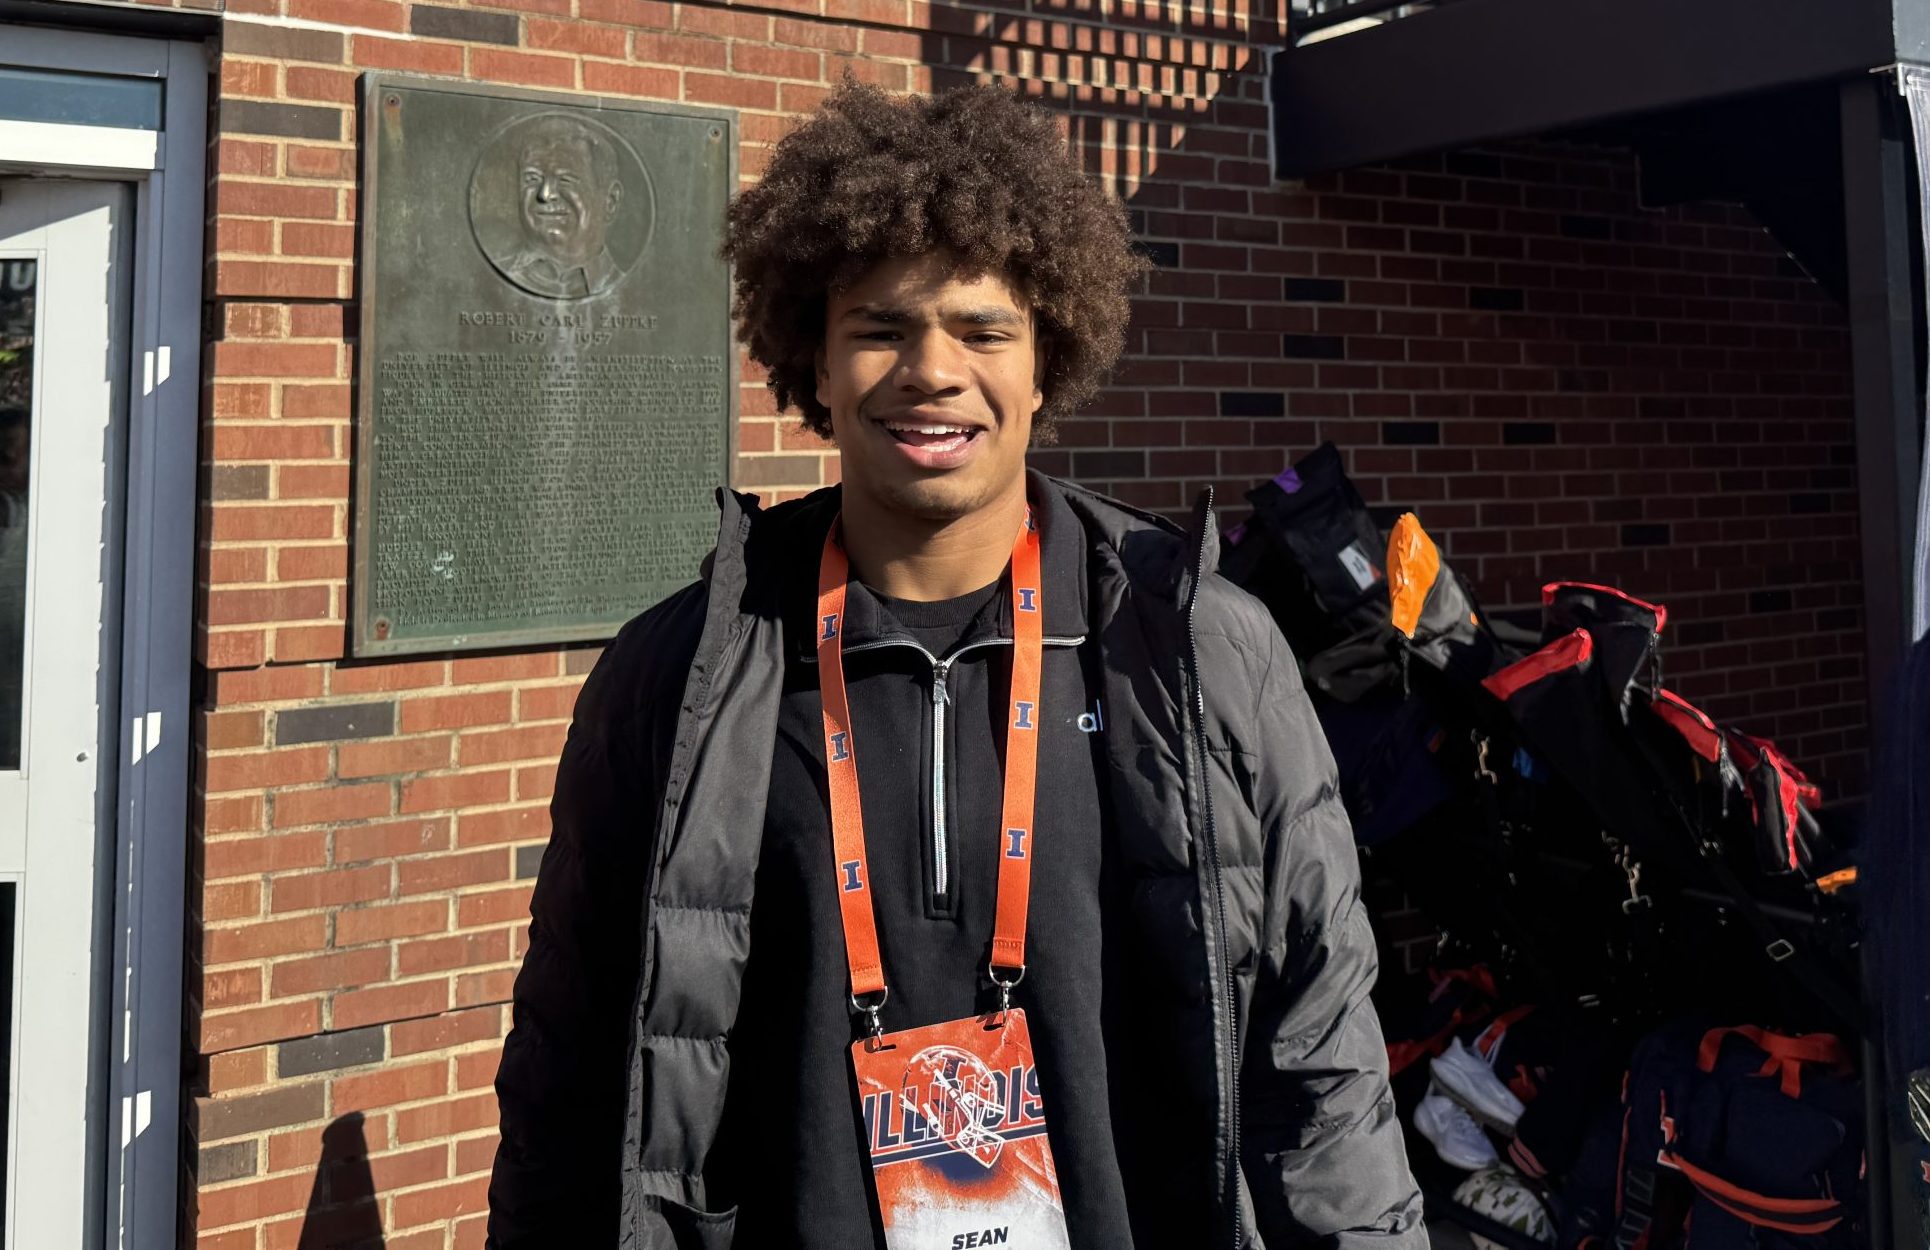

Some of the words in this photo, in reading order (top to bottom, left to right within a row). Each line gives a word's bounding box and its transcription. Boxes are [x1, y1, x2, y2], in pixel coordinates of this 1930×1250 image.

[459, 311, 526, 326] ROBERT
[540, 314, 584, 329] CARL
[509, 330, 546, 345] 1879
[1018, 588, 1036, 612] I
[821, 614, 838, 639] I
[1013, 701, 1034, 729] I
[829, 731, 849, 761] I
[1005, 828, 1027, 859] I
[842, 860, 863, 892] I
[951, 1226, 1009, 1250] SEAN
